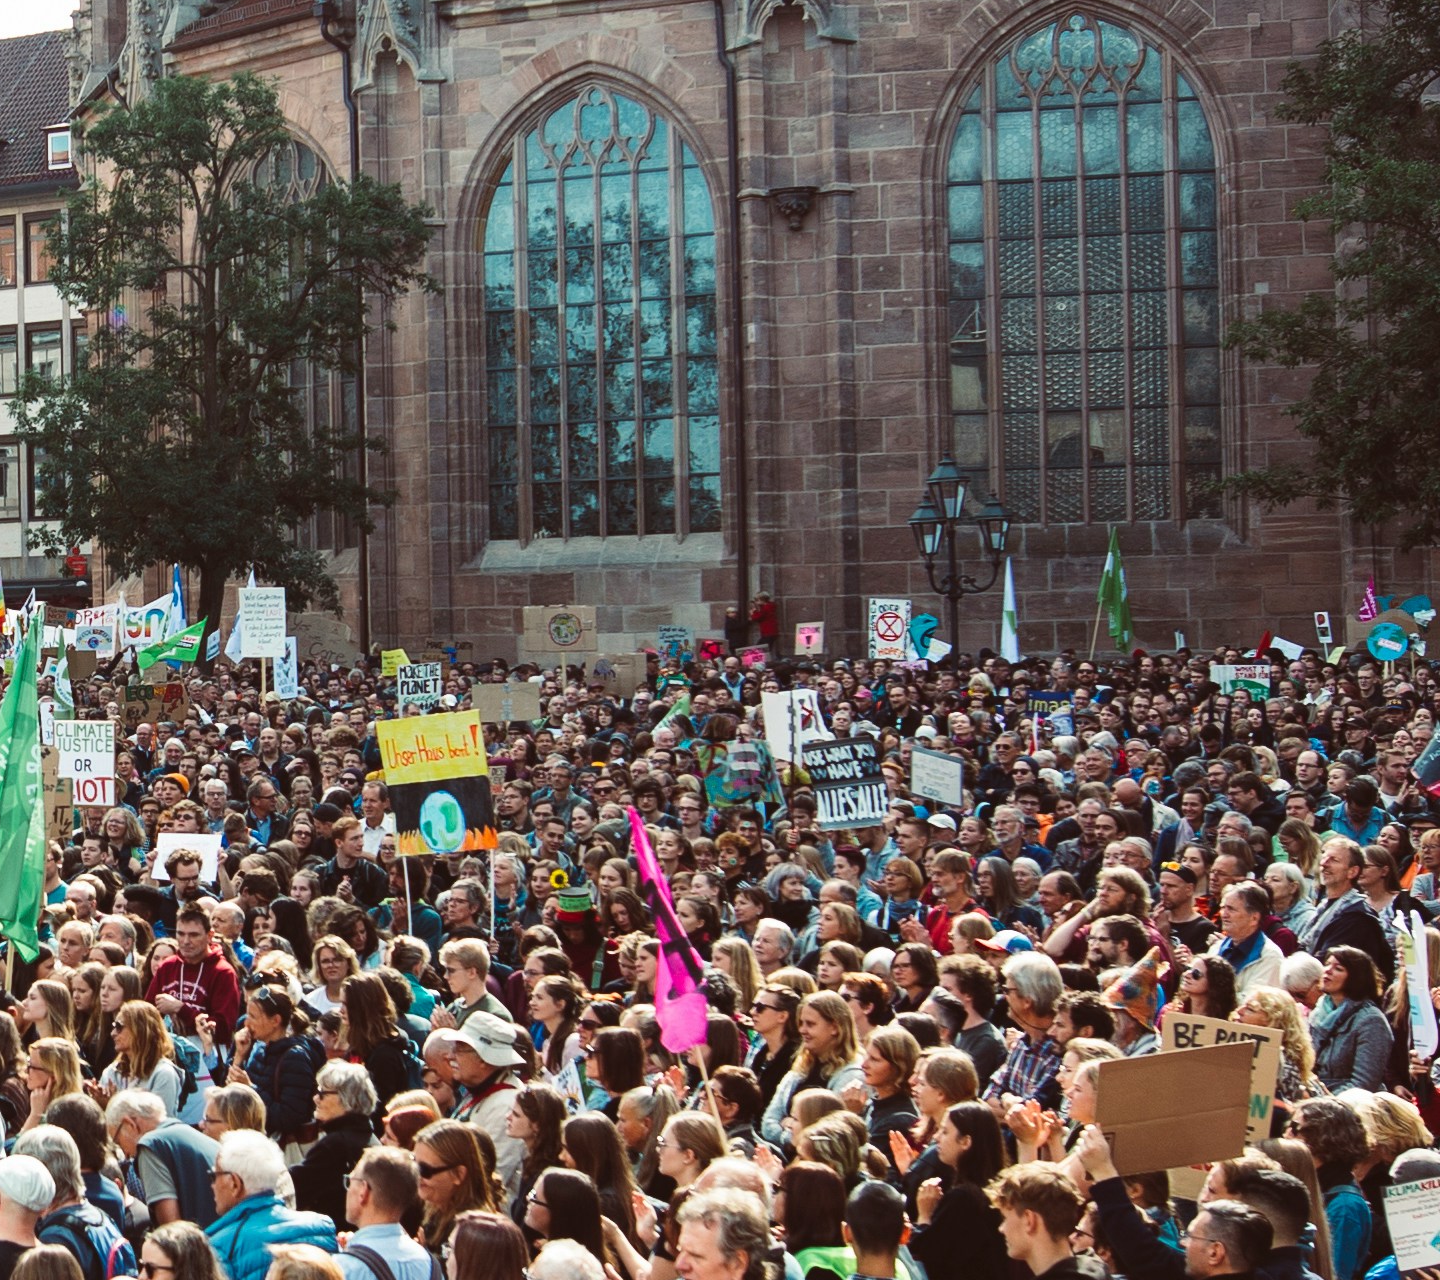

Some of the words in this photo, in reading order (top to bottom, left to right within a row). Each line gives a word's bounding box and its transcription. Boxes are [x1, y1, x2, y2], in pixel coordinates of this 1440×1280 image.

[400, 678, 440, 696] PLANET
[55, 722, 114, 739] CLIMATE
[55, 738, 114, 753] JUSTICE
[74, 759, 92, 772] OR
[802, 749, 825, 767] USE
[828, 760, 864, 780] HAVE
[1173, 1023, 1205, 1049] BE
